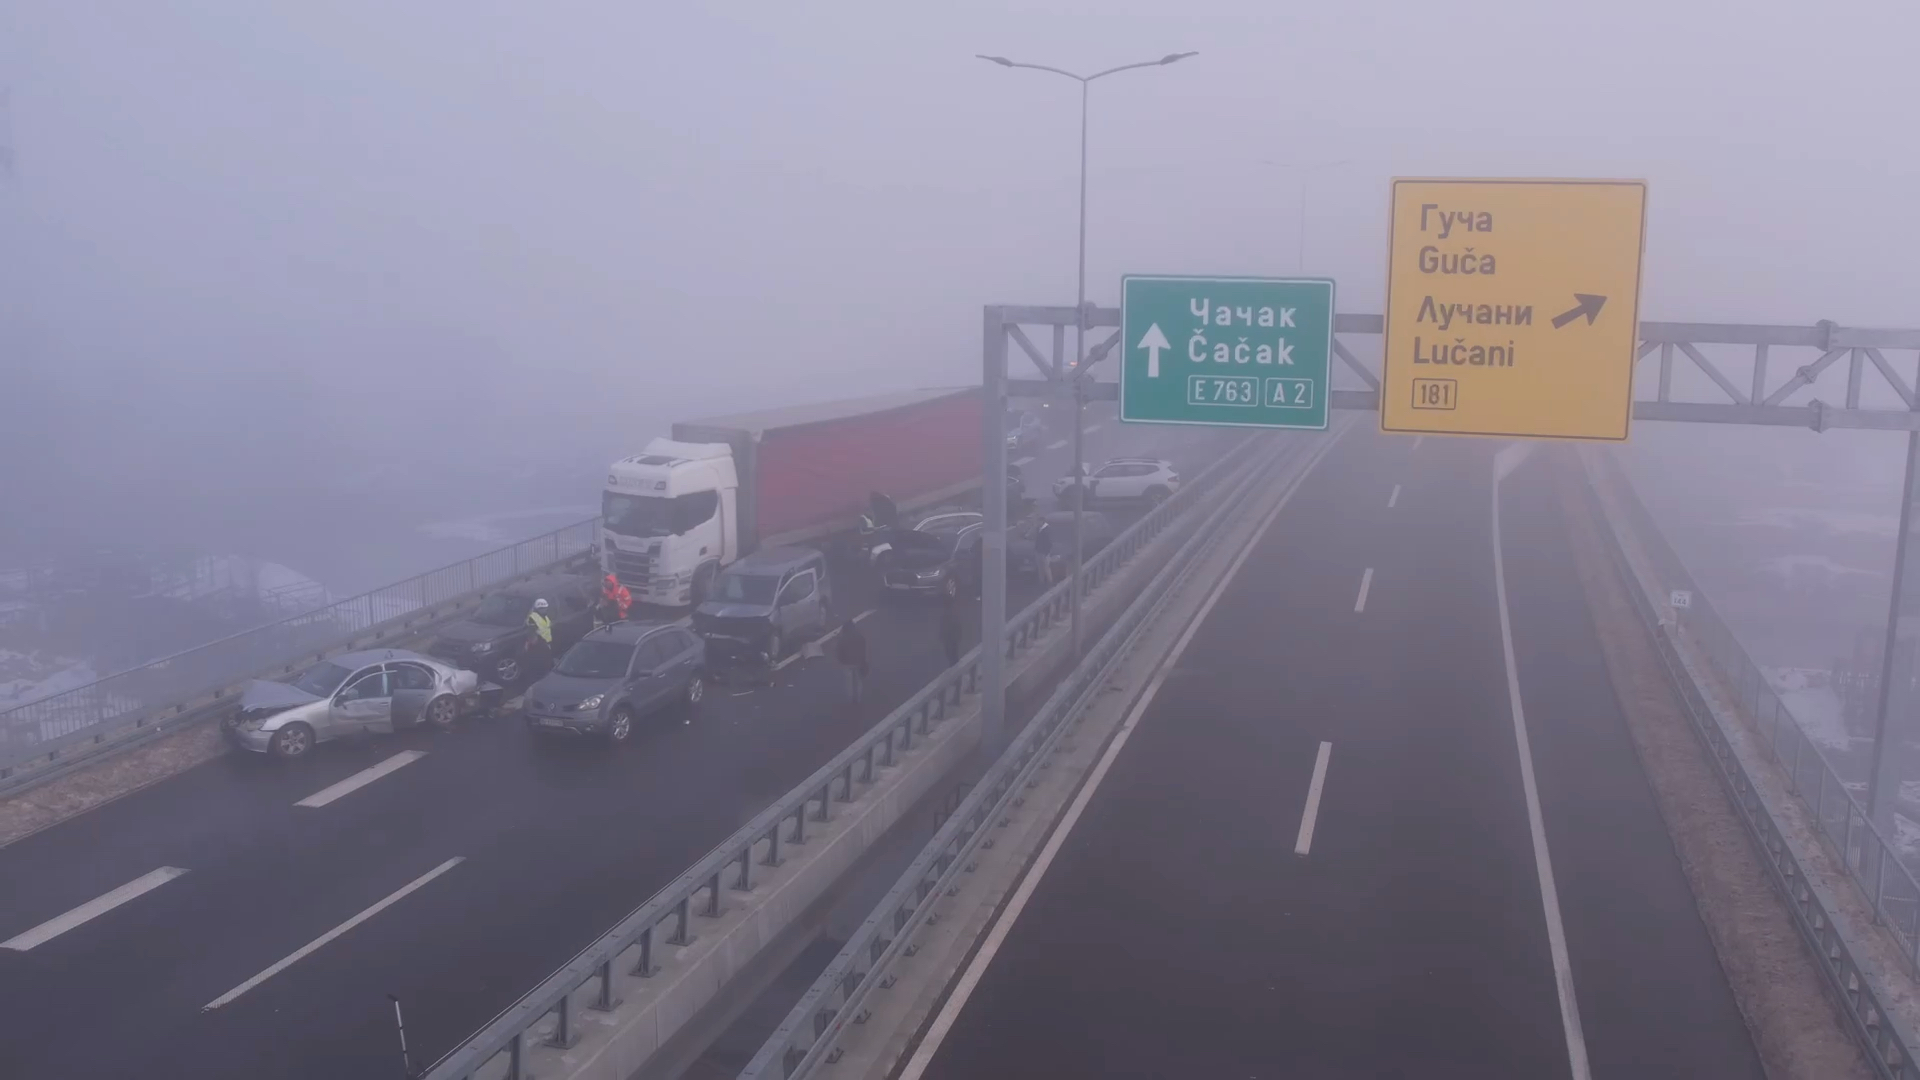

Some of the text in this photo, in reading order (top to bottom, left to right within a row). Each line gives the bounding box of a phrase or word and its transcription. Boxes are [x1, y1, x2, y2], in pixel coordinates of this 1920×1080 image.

[1420, 203, 1493, 239] Гуча
[1418, 246, 1496, 275] Guča
[1189, 298, 1297, 328] Чачак
[1416, 295, 1533, 331] Лучани
[1188, 328, 1295, 365] Čačak
[1413, 336, 1515, 367] Lučani
[1195, 380, 1252, 403] E 763
[1273, 382, 1306, 404] A 2
[1420, 384, 1449, 406] 181
